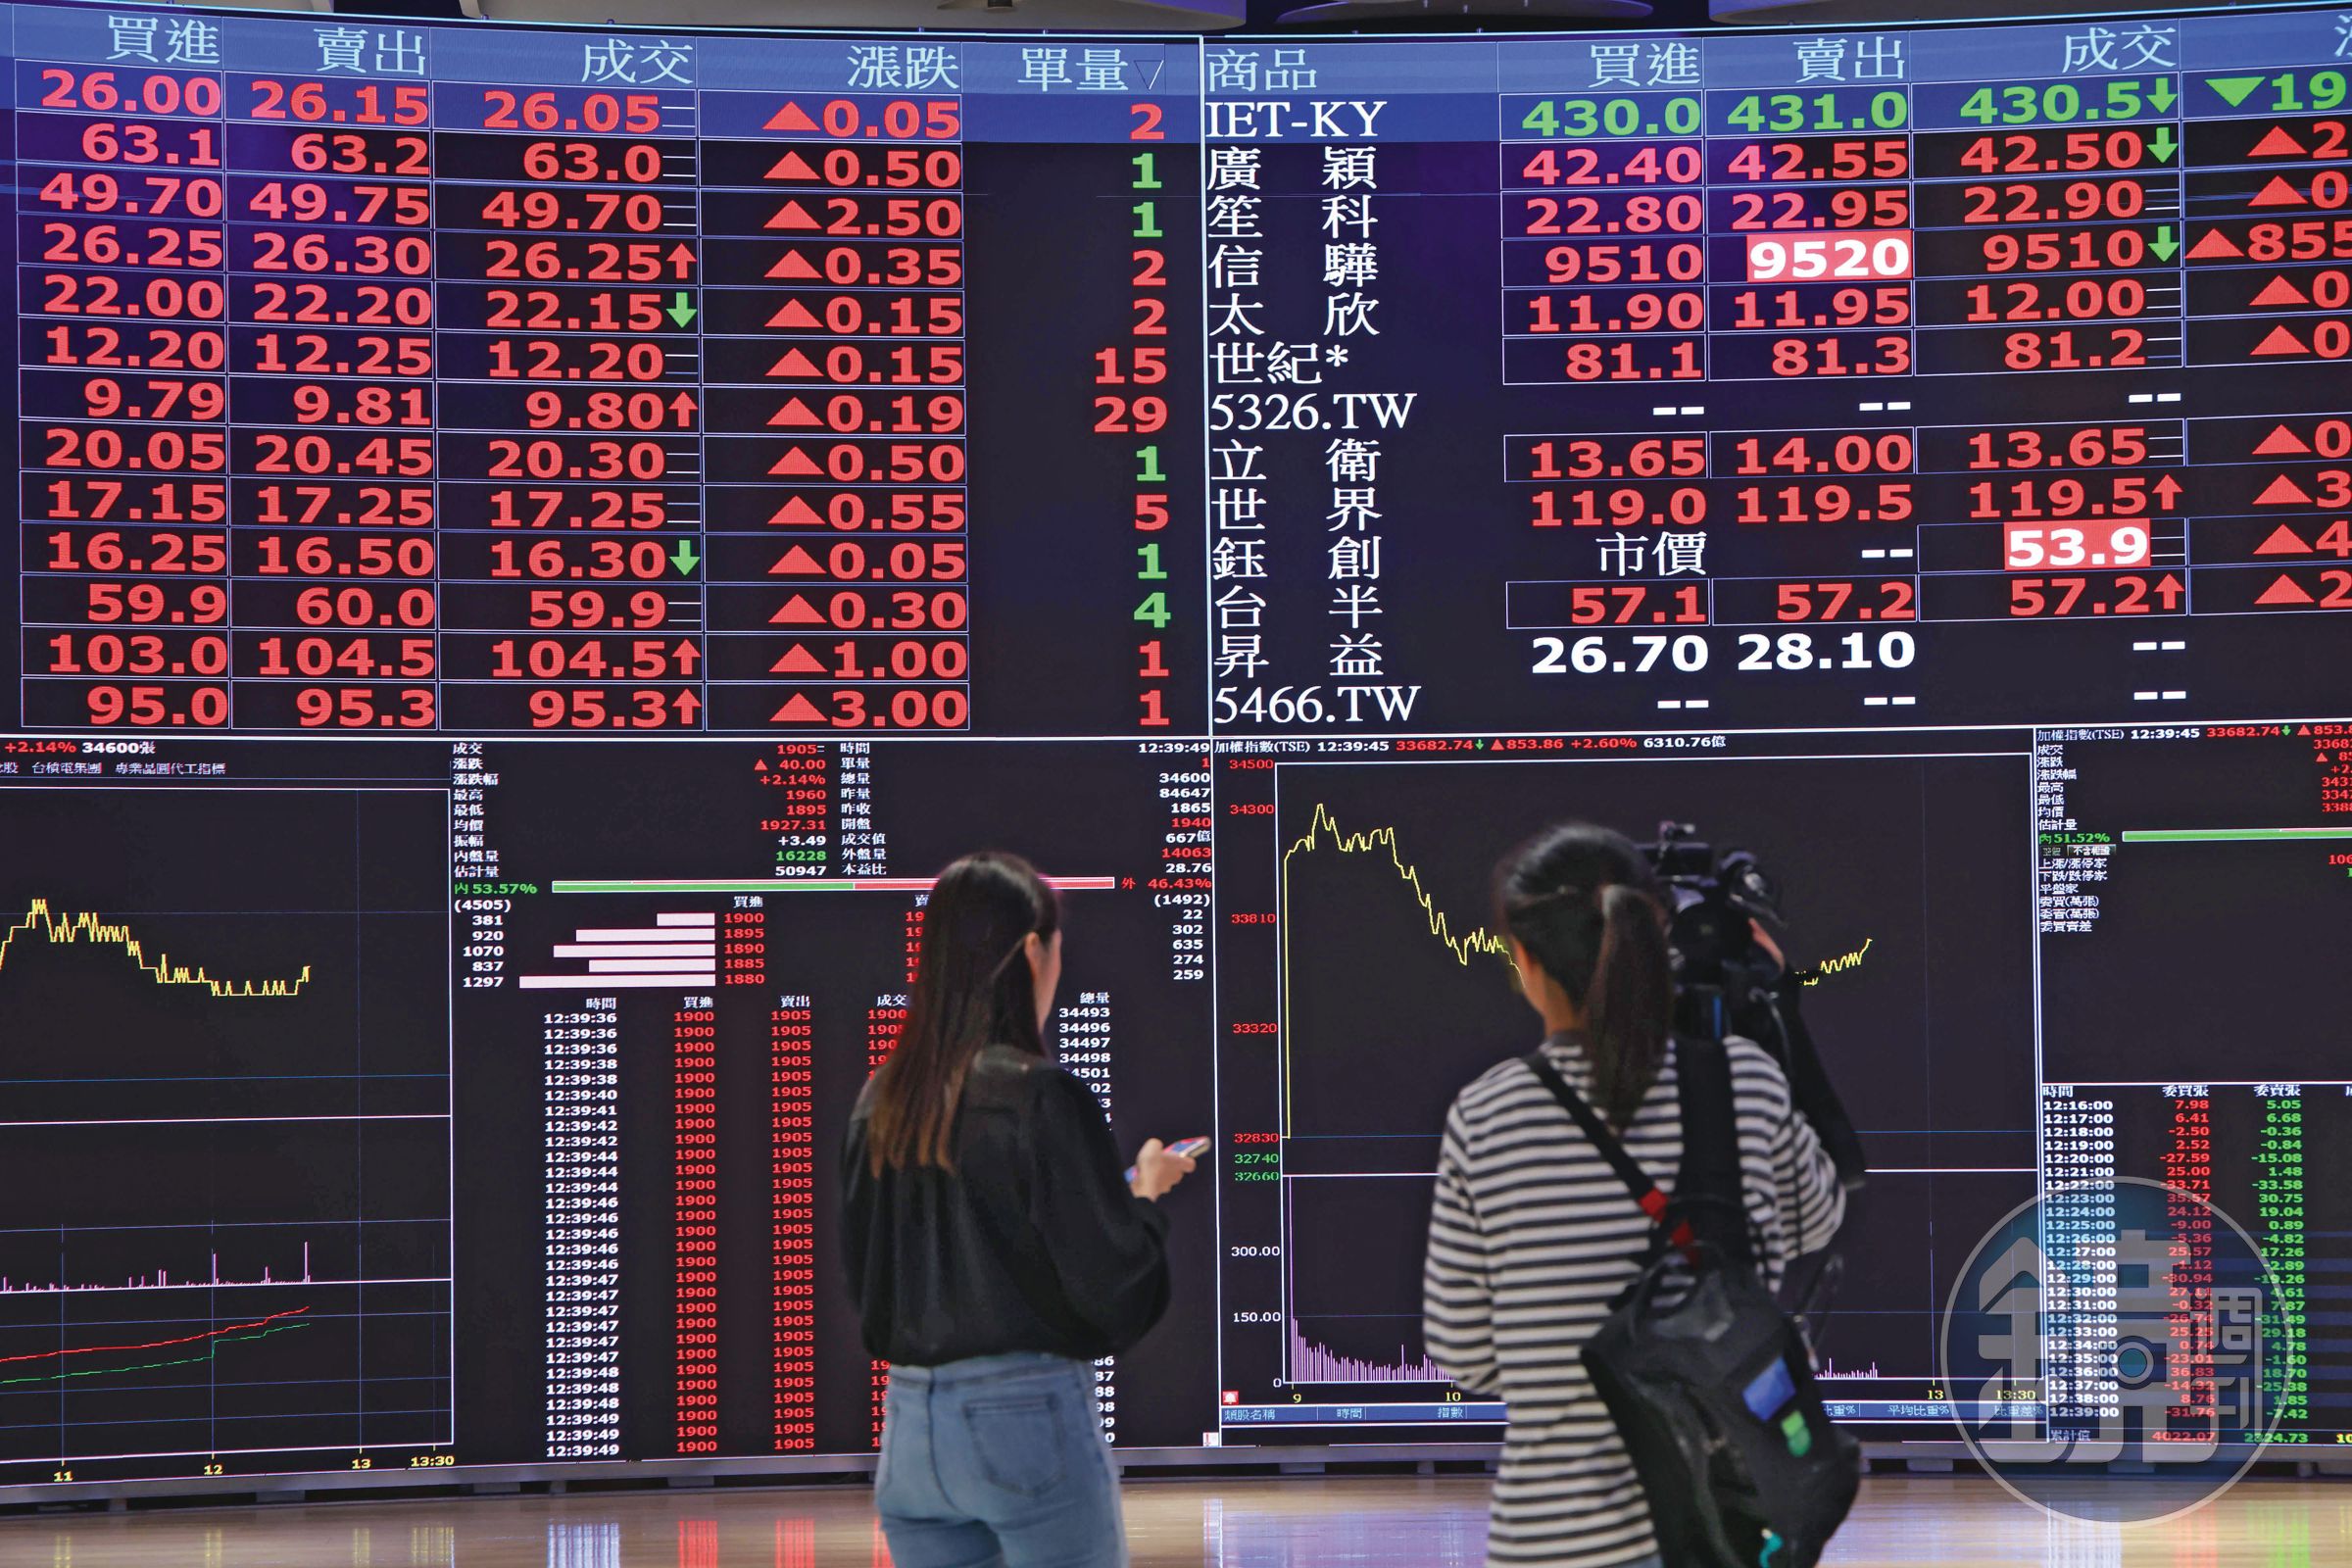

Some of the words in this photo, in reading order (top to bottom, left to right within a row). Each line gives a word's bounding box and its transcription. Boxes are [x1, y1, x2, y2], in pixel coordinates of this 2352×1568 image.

[106, 15, 220, 66] 買進
[314, 25, 425, 76] 賣出
[582, 39, 693, 83] 成交
[848, 46, 958, 89] 漲跌
[1018, 48, 1128, 91] 單量
[1206, 49, 1316, 91] 商品
[1589, 40, 1699, 87] 買進
[1795, 36, 1904, 82] 賣出
[2062, 24, 2180, 74] 成交
[41, 70, 220, 116] 26.00
[252, 80, 427, 125] 26.15
[484, 90, 659, 133] 26.05
[823, 100, 959, 139] 0.05
[1131, 104, 1164, 139] 2
[1205, 101, 1387, 137] IET-KY
[1523, 99, 1699, 136] 430.0
[1729, 92, 1907, 131] 431.0
[1960, 82, 2140, 123] 430.5
[82, 123, 220, 166] 63.1
[291, 133, 430, 174] 63.2
[523, 142, 661, 182] 63.0
[824, 149, 960, 187] 0.50
[1133, 153, 1161, 188] 1
[44, 223, 222, 268] 26.25
[254, 232, 431, 274] 26.30
[486, 240, 661, 281] 26.25
[825, 247, 961, 285] 0.35
[1133, 250, 1166, 286] 2
[1545, 244, 1702, 282] 9510
[1749, 238, 1909, 283] 9520
[1984, 229, 2143, 271] 9510
[47, 326, 223, 369] 12.20
[257, 334, 431, 375] 12.25
[490, 341, 663, 380] 12.20
[826, 346, 962, 383] 0.15
[1096, 348, 1166, 384] 15
[1566, 342, 1701, 380] 81.1
[1772, 337, 1909, 376] 81.3
[2005, 329, 2145, 369] 81.2
[1210, 393, 1417, 430] 5326.TW
[49, 481, 225, 521] 17.15
[259, 486, 433, 525] 17.25
[491, 491, 664, 529] 17.25
[829, 494, 964, 530] 0.55
[1135, 495, 1168, 530] 5
[1596, 532, 1706, 576] 市價
[2009, 526, 2147, 567] 53.9
[50, 635, 227, 674] 103.0
[260, 638, 434, 676] 104.5
[493, 641, 665, 678] 104.5
[835, 641, 966, 678] 1.00
[1140, 641, 1169, 676] 1
[1533, 635, 1708, 673] 26.70
[1739, 631, 1915, 670] 28.10
[1214, 686, 1421, 723] 5466.TW
[2037, 729, 2124, 741] 加權指數(TSE)
[2132, 728, 2199, 739] 12:39:45
[2207, 726, 2279, 737] 33682.74
[5, 741, 76, 753] +2.14%
[453, 743, 482, 754] 成交
[778, 745, 816, 755] 1905
[841, 742, 869, 754] 時間
[1140, 741, 1211, 756] 12:39:49
[1214, 738, 1311, 753] 加權指數(TSE)
[1314, 737, 1392, 751] 12:39:45
[1396, 740, 1473, 751] 33682.74
[1506, 739, 1563, 749] 853.86
[1571, 738, 1637, 749] +2.60%
[453, 759, 482, 769] 漲跌
[779, 760, 825, 769] 40.00
[841, 758, 869, 769] 單量
[1202, 758, 1209, 767] 1
[1230, 760, 1273, 768] 34500
[454, 773, 498, 785] 漲跌幅
[760, 774, 825, 785] +2.14%
[841, 772, 870, 784] 總量
[1159, 773, 1211, 783] 34600
[454, 835, 483, 847] 振幅
[779, 836, 826, 846] +3.49
[842, 833, 885, 845] 成交值
[455, 851, 499, 862] 內盤量
[777, 851, 826, 860] 16228
[842, 848, 886, 860] 外盤量
[1162, 848, 1211, 858] 14063
[455, 865, 499, 877] 估計量
[775, 866, 827, 877] 50947
[843, 863, 886, 875] 本益比
[1166, 863, 1211, 872] 28.76
[455, 883, 468, 894] 內
[473, 884, 537, 894] 53.57%
[1122, 878, 1136, 889] 外
[1148, 878, 1211, 889] 46.43%
[455, 900, 511, 912] (4505)
[1154, 894, 1209, 906] (1492)
[472, 915, 503, 925] 381
[724, 913, 764, 923] 1900
[1183, 909, 1202, 919] 22
[1232, 914, 1275, 923] 33810
[586, 998, 616, 1009] 時間
[684, 997, 712, 1008] 買進
[781, 996, 809, 1007] 賣出
[1080, 992, 1109, 1004] 總量
[545, 1013, 616, 1023] 12:39:36
[674, 1011, 713, 1021] 1900
[772, 1010, 810, 1020] 1905
[1059, 1007, 1109, 1017] 34493
[546, 1105, 616, 1116] 12:39:41
[675, 1103, 715, 1113] 1900
[772, 1102, 811, 1112] 1905
[2044, 1102, 2113, 1110] 12:16:00
[2176, 1100, 2209, 1109] 7.98
[2267, 1101, 2301, 1109] 5.05
[2044, 1127, 2113, 1137] 12:18:00
[2169, 1126, 2210, 1136] -2.50
[2261, 1127, 2302, 1136] -0.36
[1234, 1152, 1279, 1164] 32740
[1232, 1247, 1280, 1256] 300.00
[1446, 1393, 1460, 1401] 10
[547, 1445, 619, 1456] 12:39:49
[677, 1441, 717, 1452] 1900
[775, 1439, 814, 1449] 1905
[55, 1471, 72, 1482] 11
[205, 1465, 222, 1475] 12
[353, 1459, 370, 1469] 13
[412, 1456, 454, 1466] 13:30
